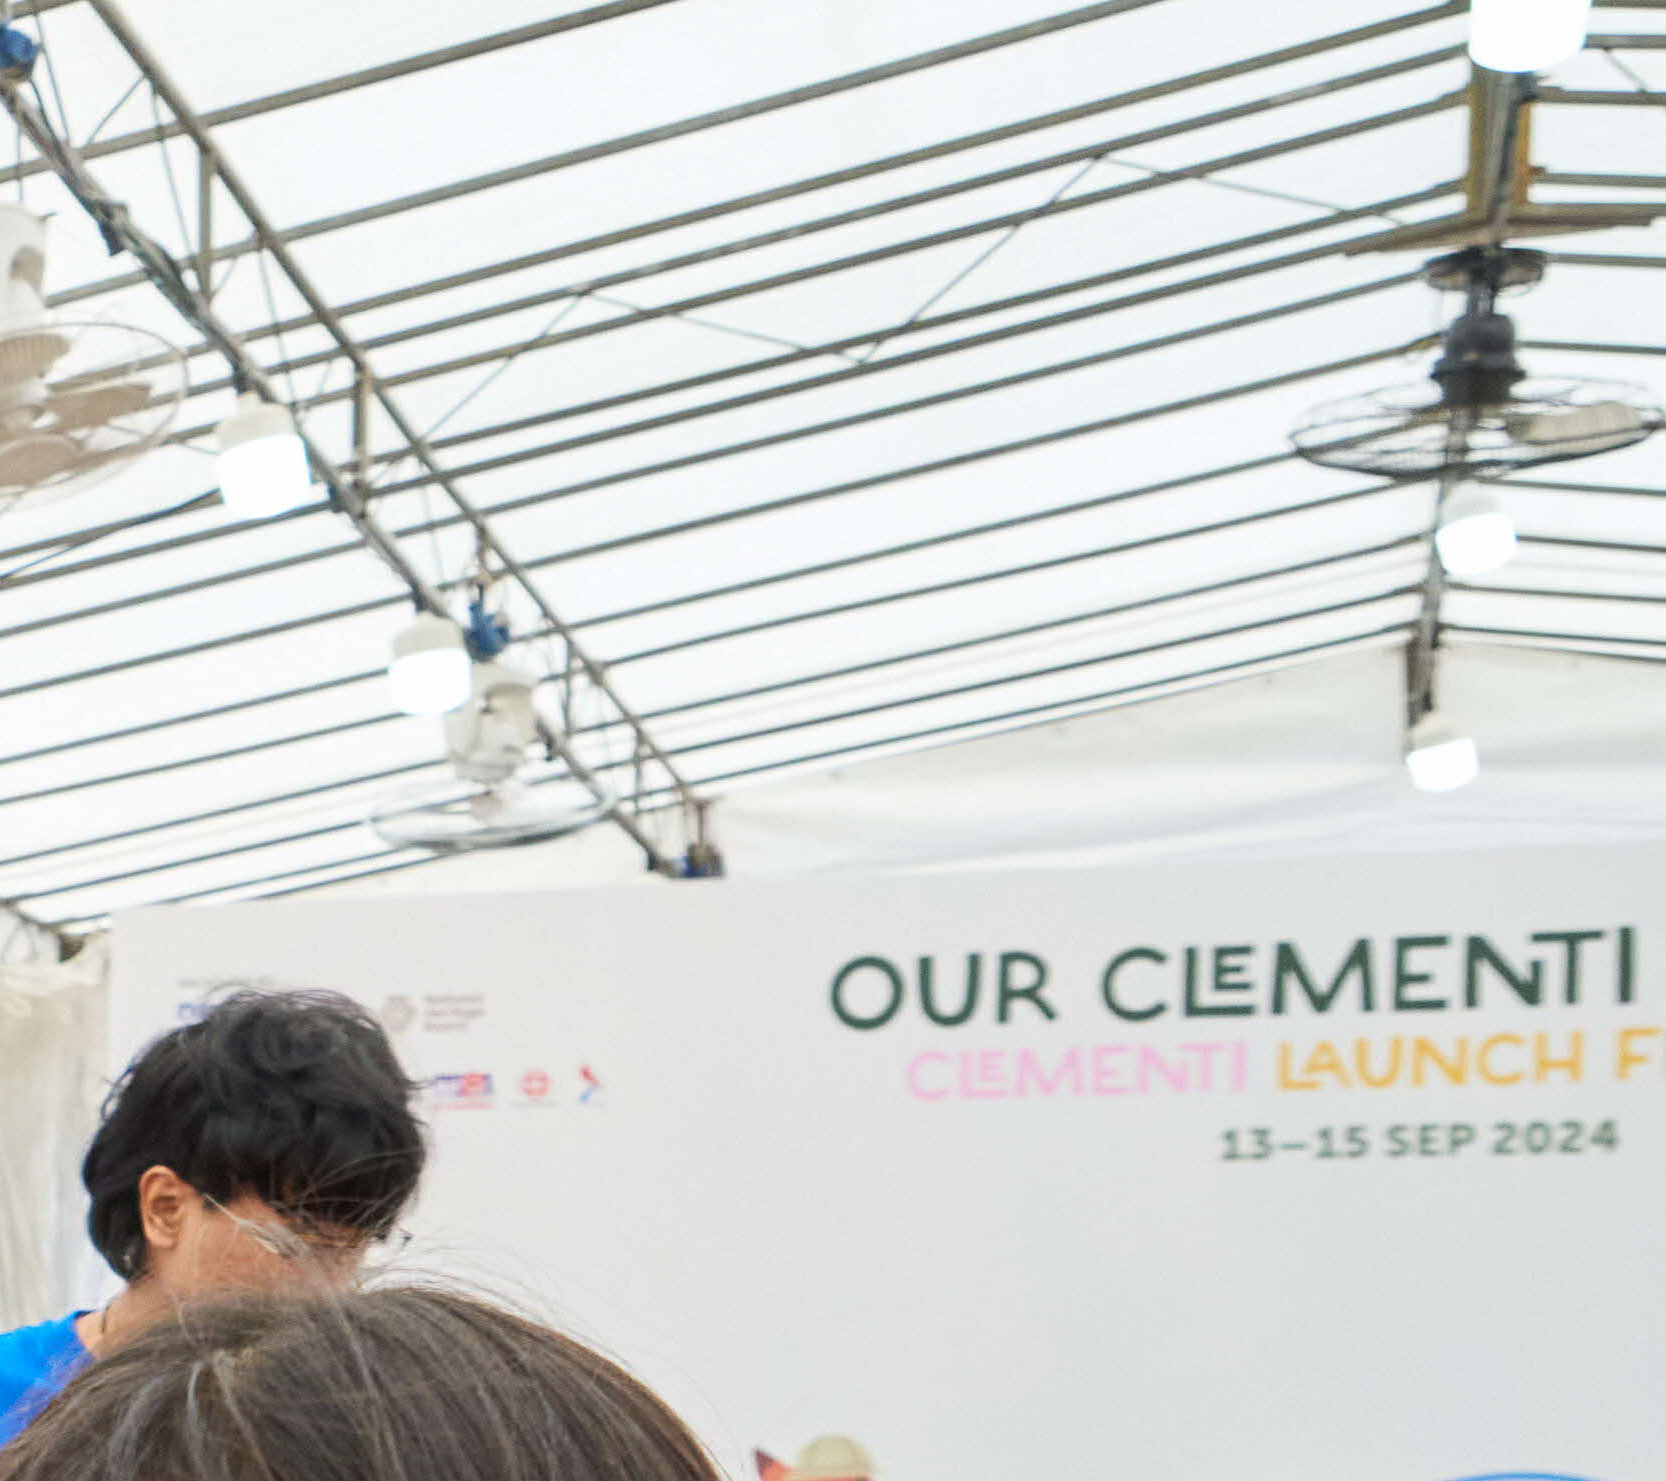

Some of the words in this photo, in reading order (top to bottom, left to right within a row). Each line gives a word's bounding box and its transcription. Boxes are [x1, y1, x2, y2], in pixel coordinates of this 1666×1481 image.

[829, 950, 1059, 1031] OUR
[1102, 925, 1638, 1022] CLEMENTI
[906, 1040, 1248, 1102] CLEMENTI
[1275, 1029, 1586, 1091] LAUNCH
[1615, 1025, 1666, 1081] F
[1385, 1123, 1477, 1157] SEP
[1492, 1118, 1621, 1157] 2024
